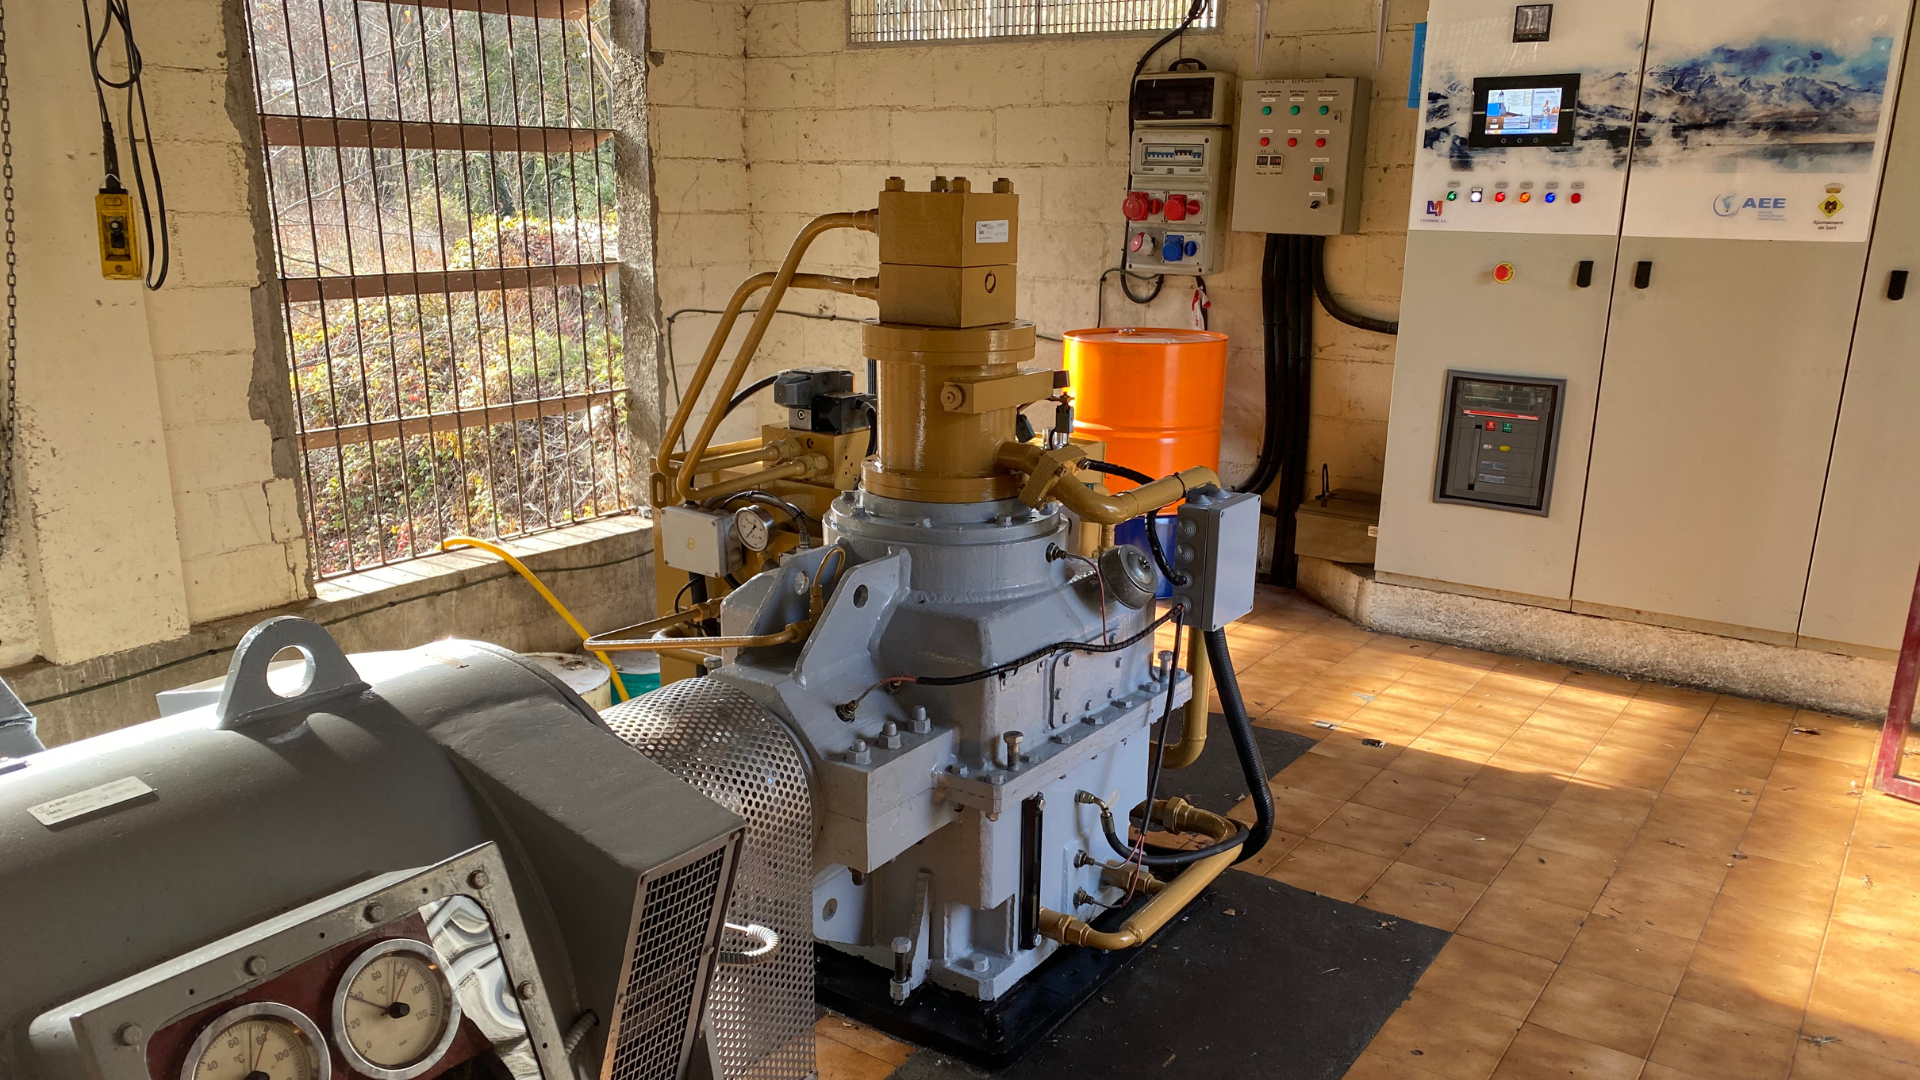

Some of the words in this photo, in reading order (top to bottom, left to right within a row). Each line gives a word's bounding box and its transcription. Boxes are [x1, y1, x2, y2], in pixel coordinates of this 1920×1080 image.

[1741, 198, 1787, 209] AEE
[371, 970, 382, 981] 60
[395, 969, 406, 980] 80
[411, 983, 425, 996] 100
[415, 1009, 428, 1021] 120
[350, 1018, 361, 1029] 20
[227, 1036, 240, 1049] 60
[255, 1033, 268, 1046] 80
[365, 1040, 372, 1049] 0
[274, 1049, 290, 1063] 100
[206, 1060, 218, 1072] 40
